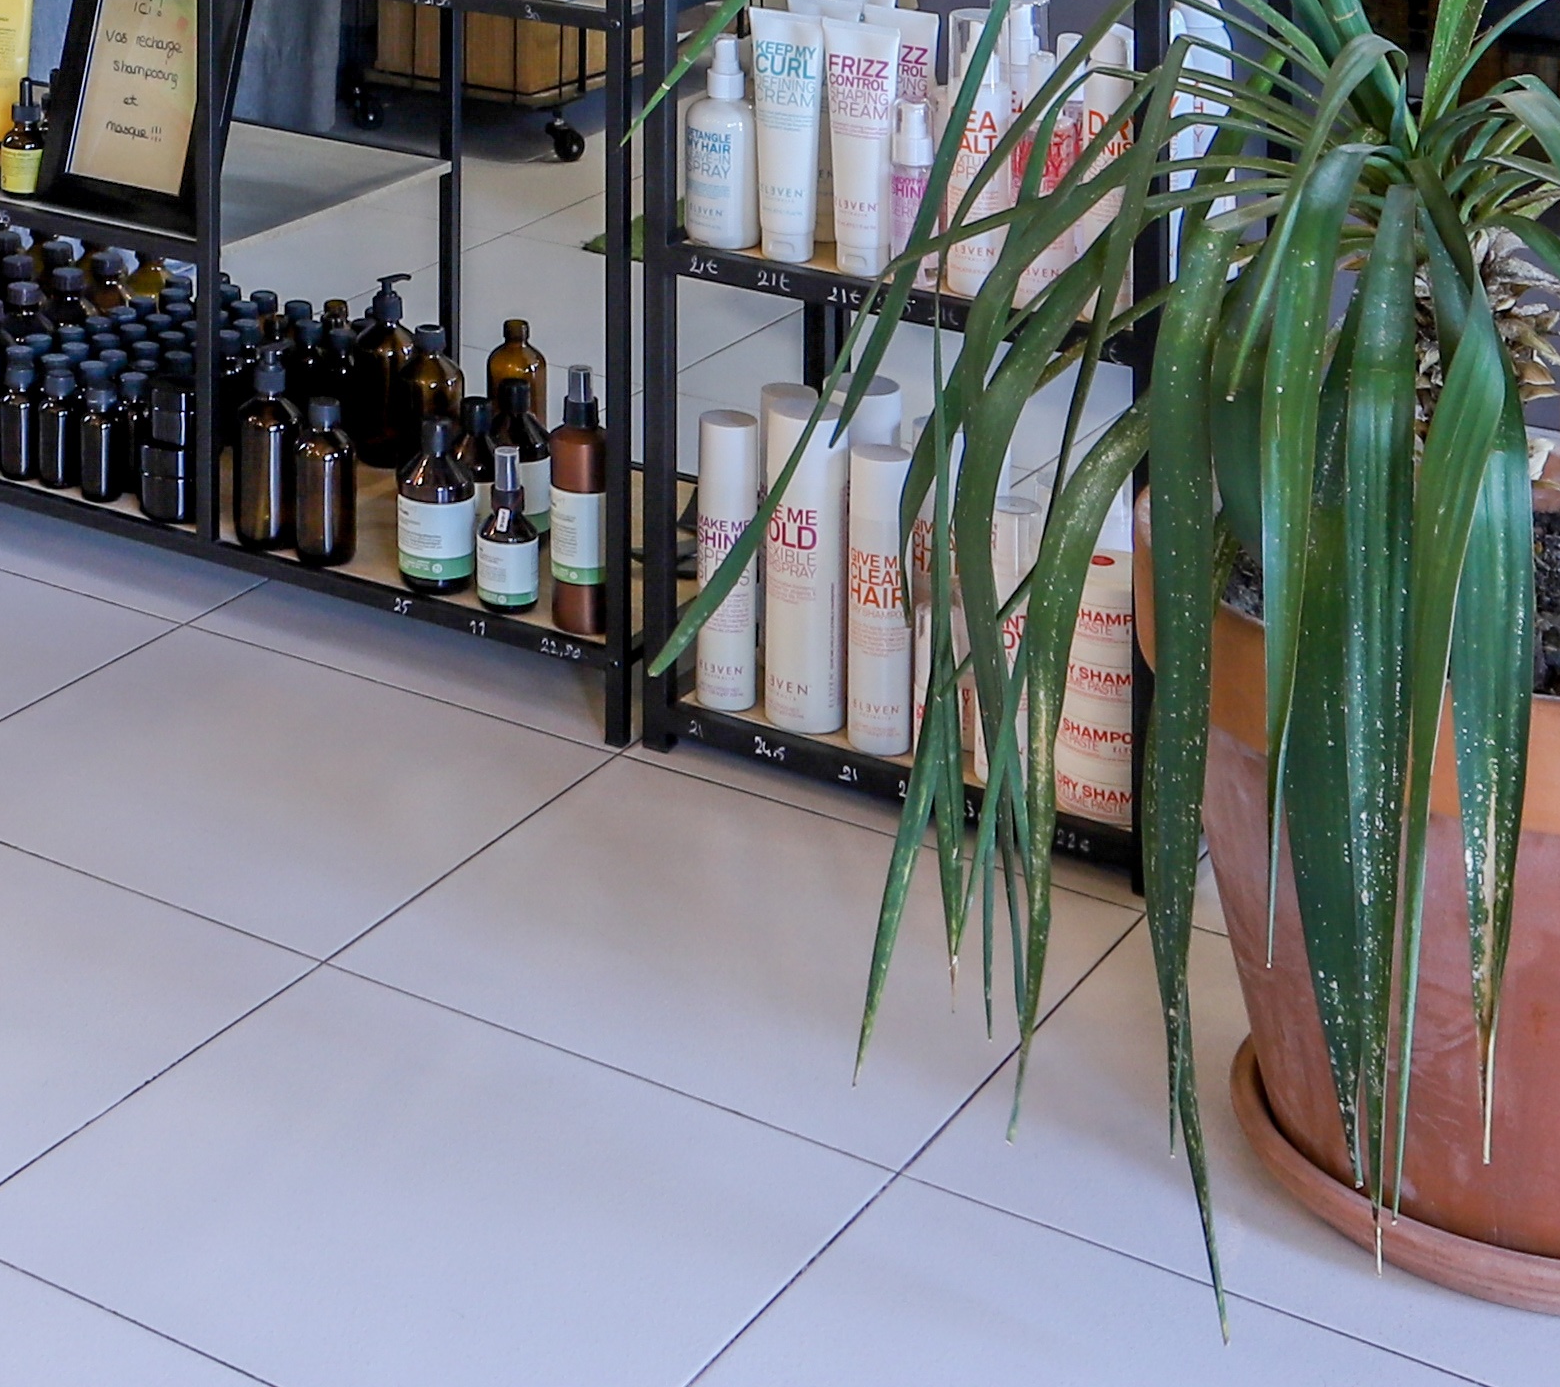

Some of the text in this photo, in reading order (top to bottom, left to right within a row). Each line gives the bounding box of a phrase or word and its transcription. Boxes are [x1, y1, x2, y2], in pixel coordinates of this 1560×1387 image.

[106, 29, 183, 58] Vos recharge
[755, 40, 817, 60] KEEP MY
[755, 53, 817, 80] CURL
[829, 54, 890, 80] FRIZZ
[755, 74, 816, 94] DEFINING
[829, 73, 888, 93] CONTROL
[123, 96, 138, 107] et
[756, 88, 815, 108] CREAM
[830, 88, 889, 106] SHAPING
[830, 100, 890, 121] CREAM
[106, 120, 149, 140] masque
[687, 138, 731, 155] MY HAIR
[687, 160, 731, 179] SPRAY
[698, 513, 728, 533] MAKE
[787, 508, 818, 527] ME
[698, 529, 738, 550] SHIN
[851, 547, 880, 569] GIVE
[394, 598, 413, 614] 25
[1056, 770, 1078, 792] DRY
